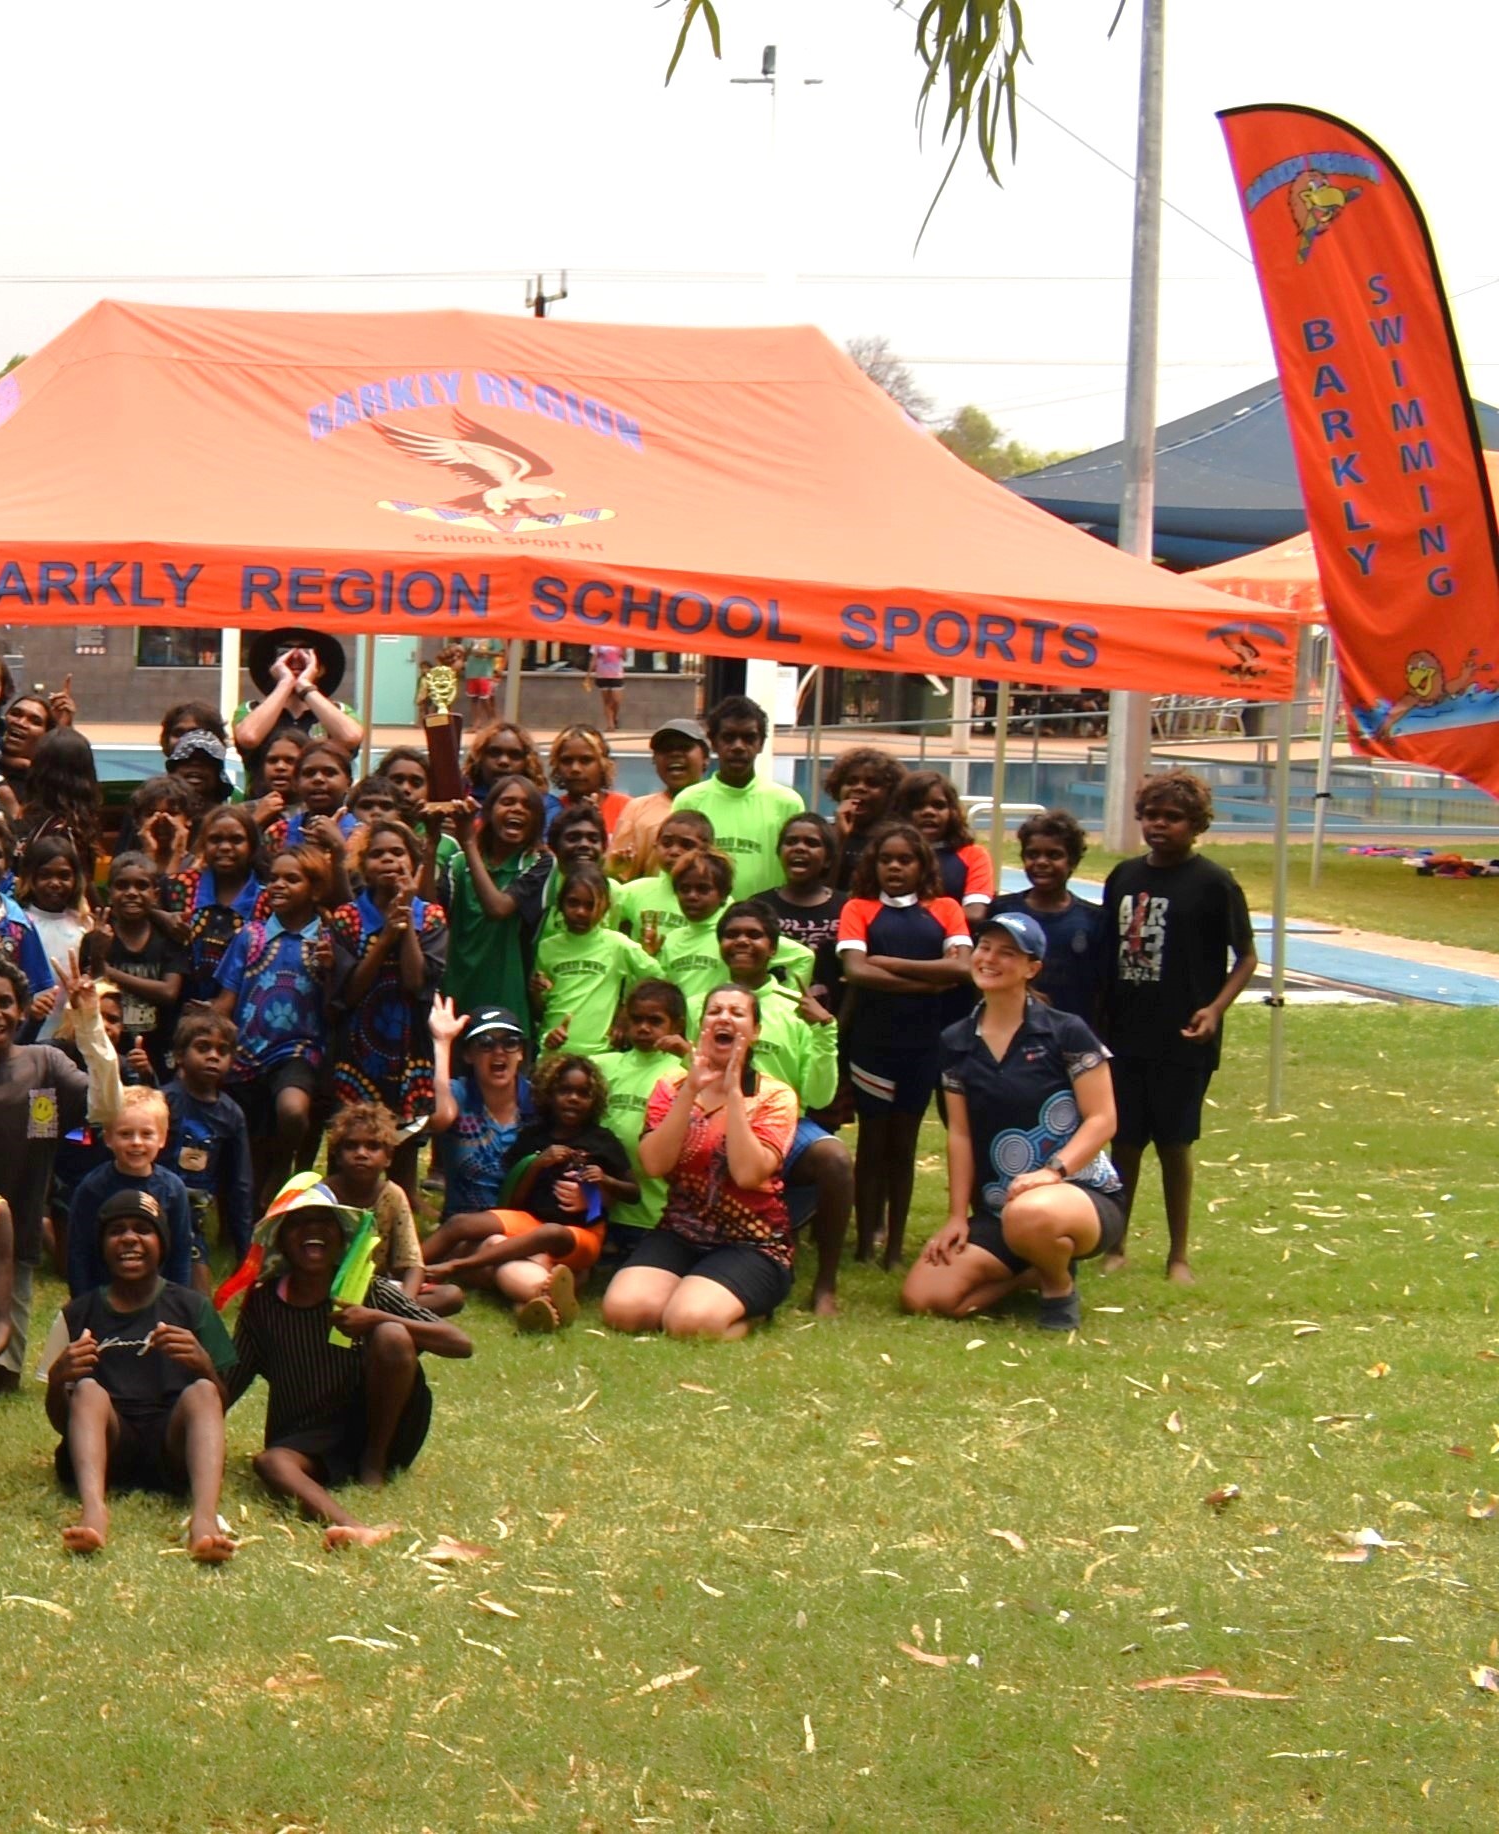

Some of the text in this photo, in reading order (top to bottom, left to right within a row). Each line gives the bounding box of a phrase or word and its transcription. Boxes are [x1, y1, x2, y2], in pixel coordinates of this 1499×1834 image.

[307, 371, 645, 455] BARKLY REGION
[1302, 317, 1379, 577] BARKLY
[1367, 274, 1453, 597] SWIMMING
[414, 533, 495, 546] SCHOOL
[502, 536, 572, 549] SPORT
[240, 565, 491, 617] REGION
[530, 575, 802, 644] SCHOOL
[839, 604, 1099, 669] SPORTS
